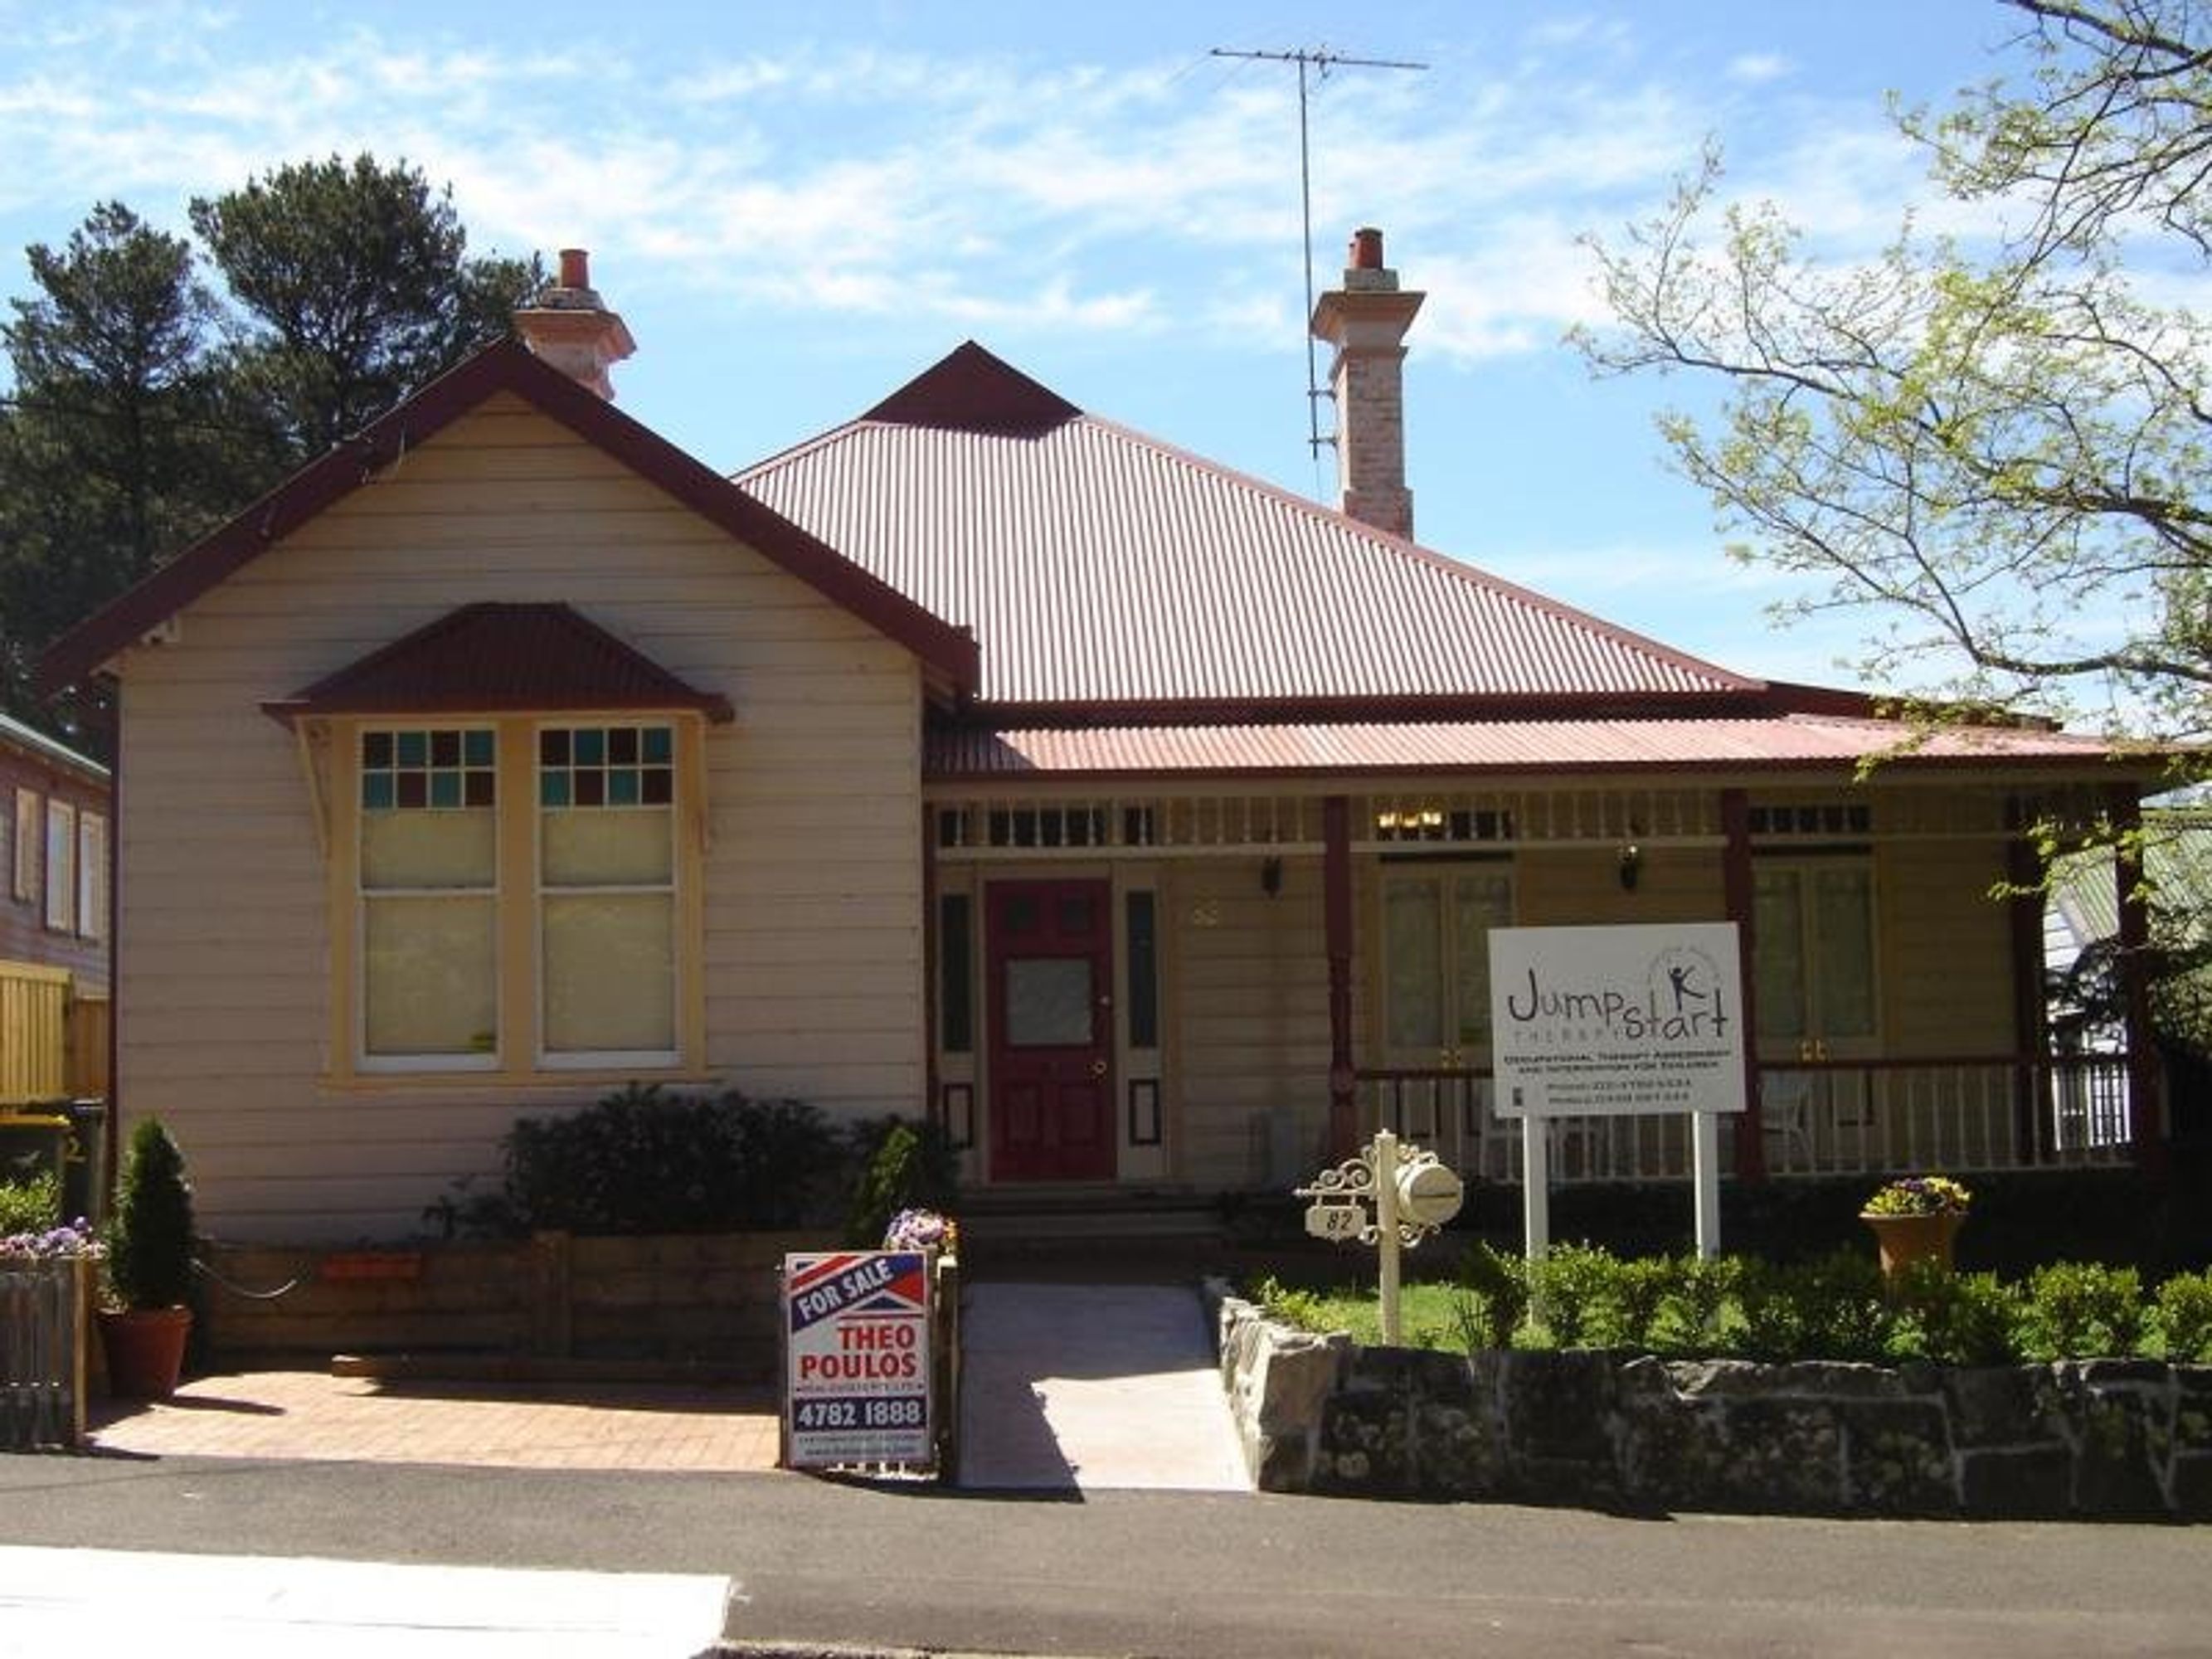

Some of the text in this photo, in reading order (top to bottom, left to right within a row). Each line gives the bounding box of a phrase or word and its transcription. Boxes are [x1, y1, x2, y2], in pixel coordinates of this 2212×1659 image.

[1327, 1212, 1354, 1231] 82
[796, 1258, 894, 1321] FOR SALE
[838, 1324, 916, 1350] THEO
[800, 1353, 917, 1379] POULOS
[799, 1399, 921, 1426] 4782 1888
